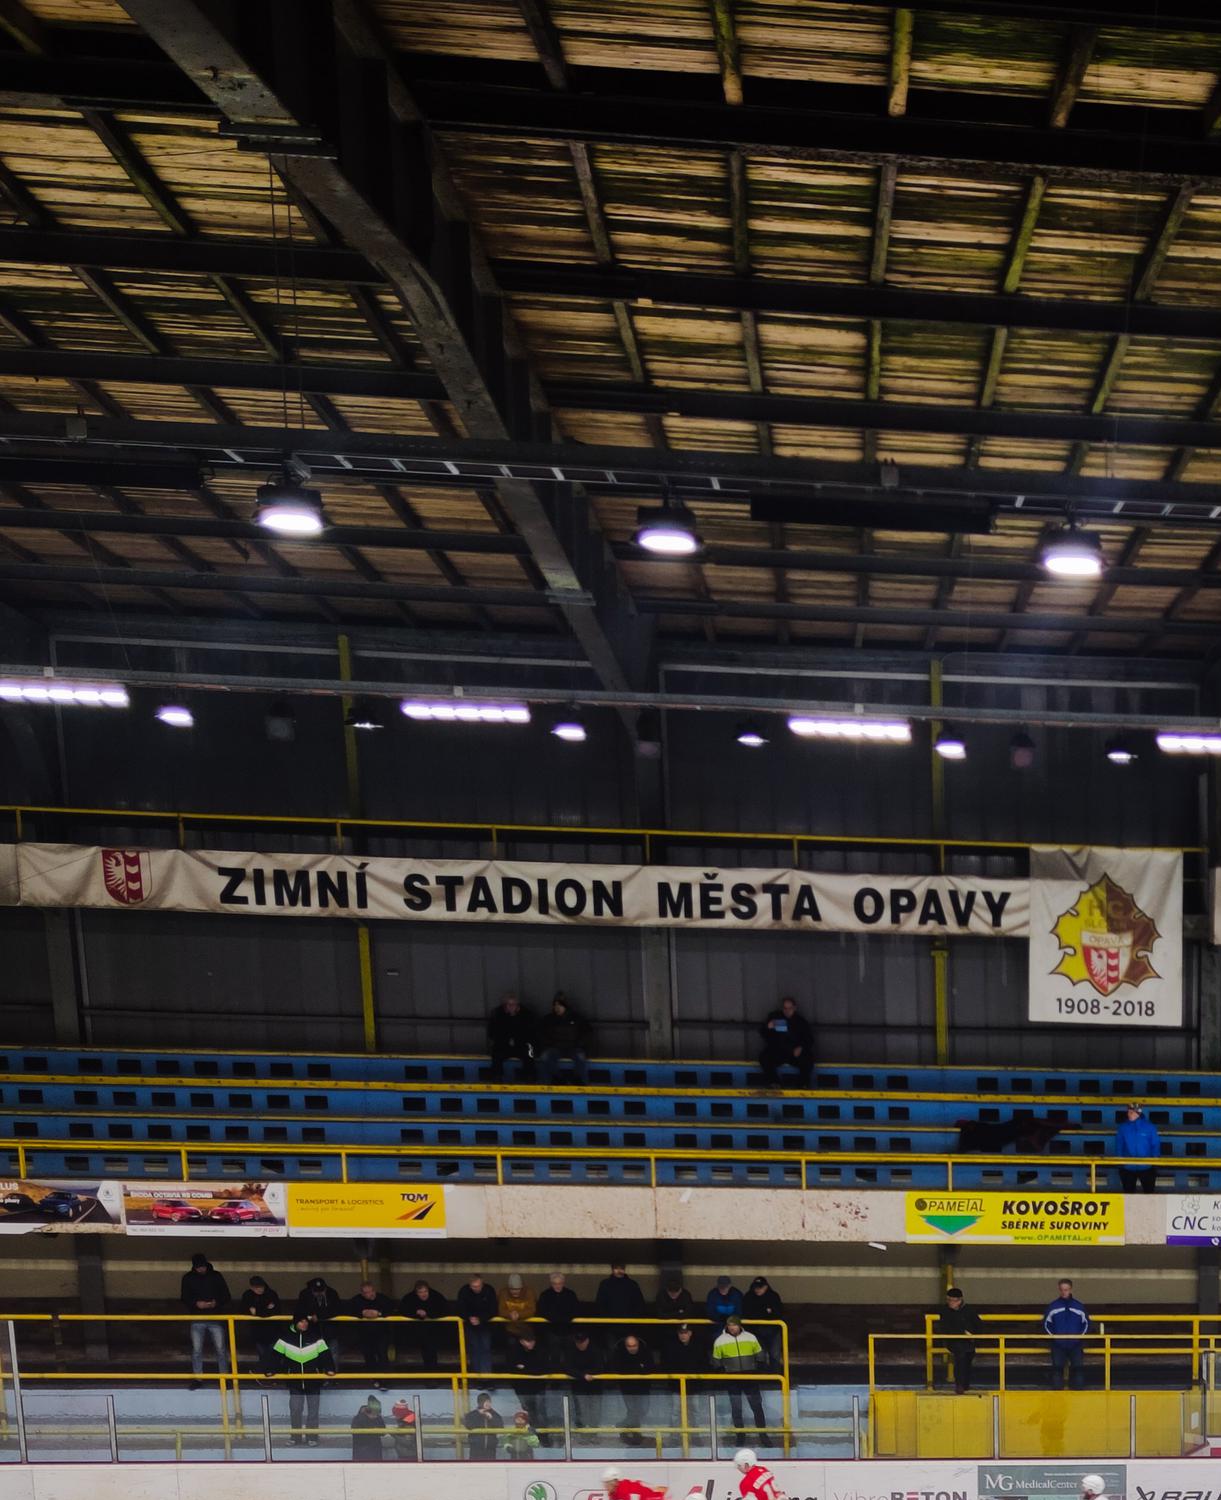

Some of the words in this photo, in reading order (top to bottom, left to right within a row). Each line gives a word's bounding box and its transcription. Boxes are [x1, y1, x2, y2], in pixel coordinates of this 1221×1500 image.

[216, 862, 369, 909] ZIMNÍ
[402, 873, 624, 918] STADION
[657, 872, 822, 922] MĚSTA
[853, 887, 1012, 928] OPAVY
[1056, 997, 1155, 1017] 1908-2018
[401, 1193, 428, 1203] TQM
[1002, 1196, 1110, 1216] KOVOŠROT
[1049, 1220, 1109, 1231] SUROVINY
[1172, 1216, 1209, 1230] CNC
